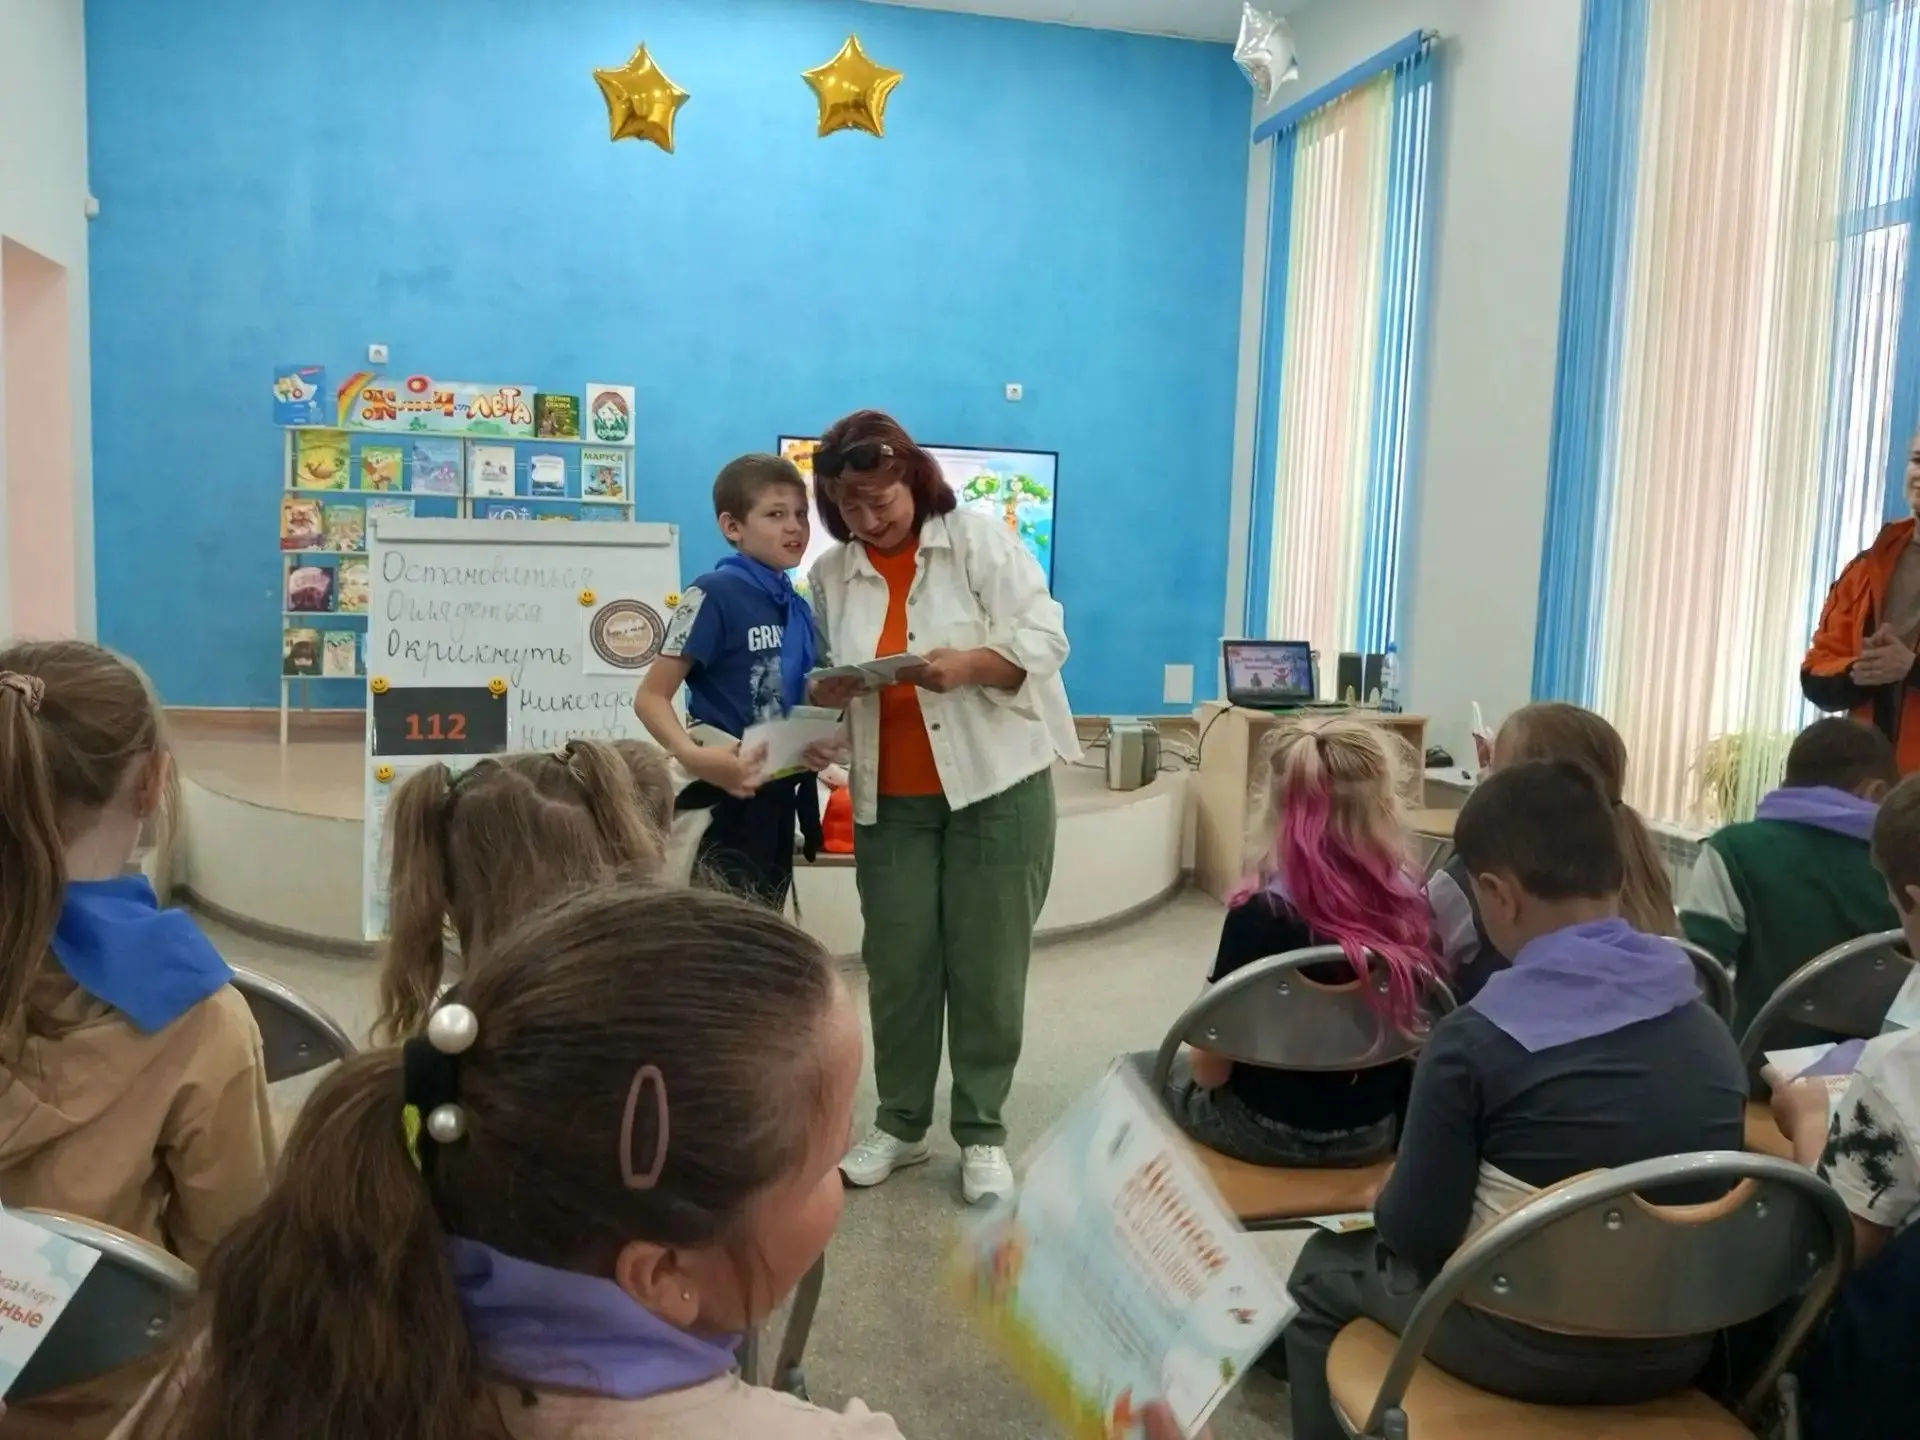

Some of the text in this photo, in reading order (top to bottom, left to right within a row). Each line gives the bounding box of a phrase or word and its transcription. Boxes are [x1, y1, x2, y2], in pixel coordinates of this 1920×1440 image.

[583, 452, 624, 462] МАРУСЯ
[386, 628, 574, 688] Окрикнуть
[404, 713, 467, 741] 112
[0, 1298, 44, 1328] ные
